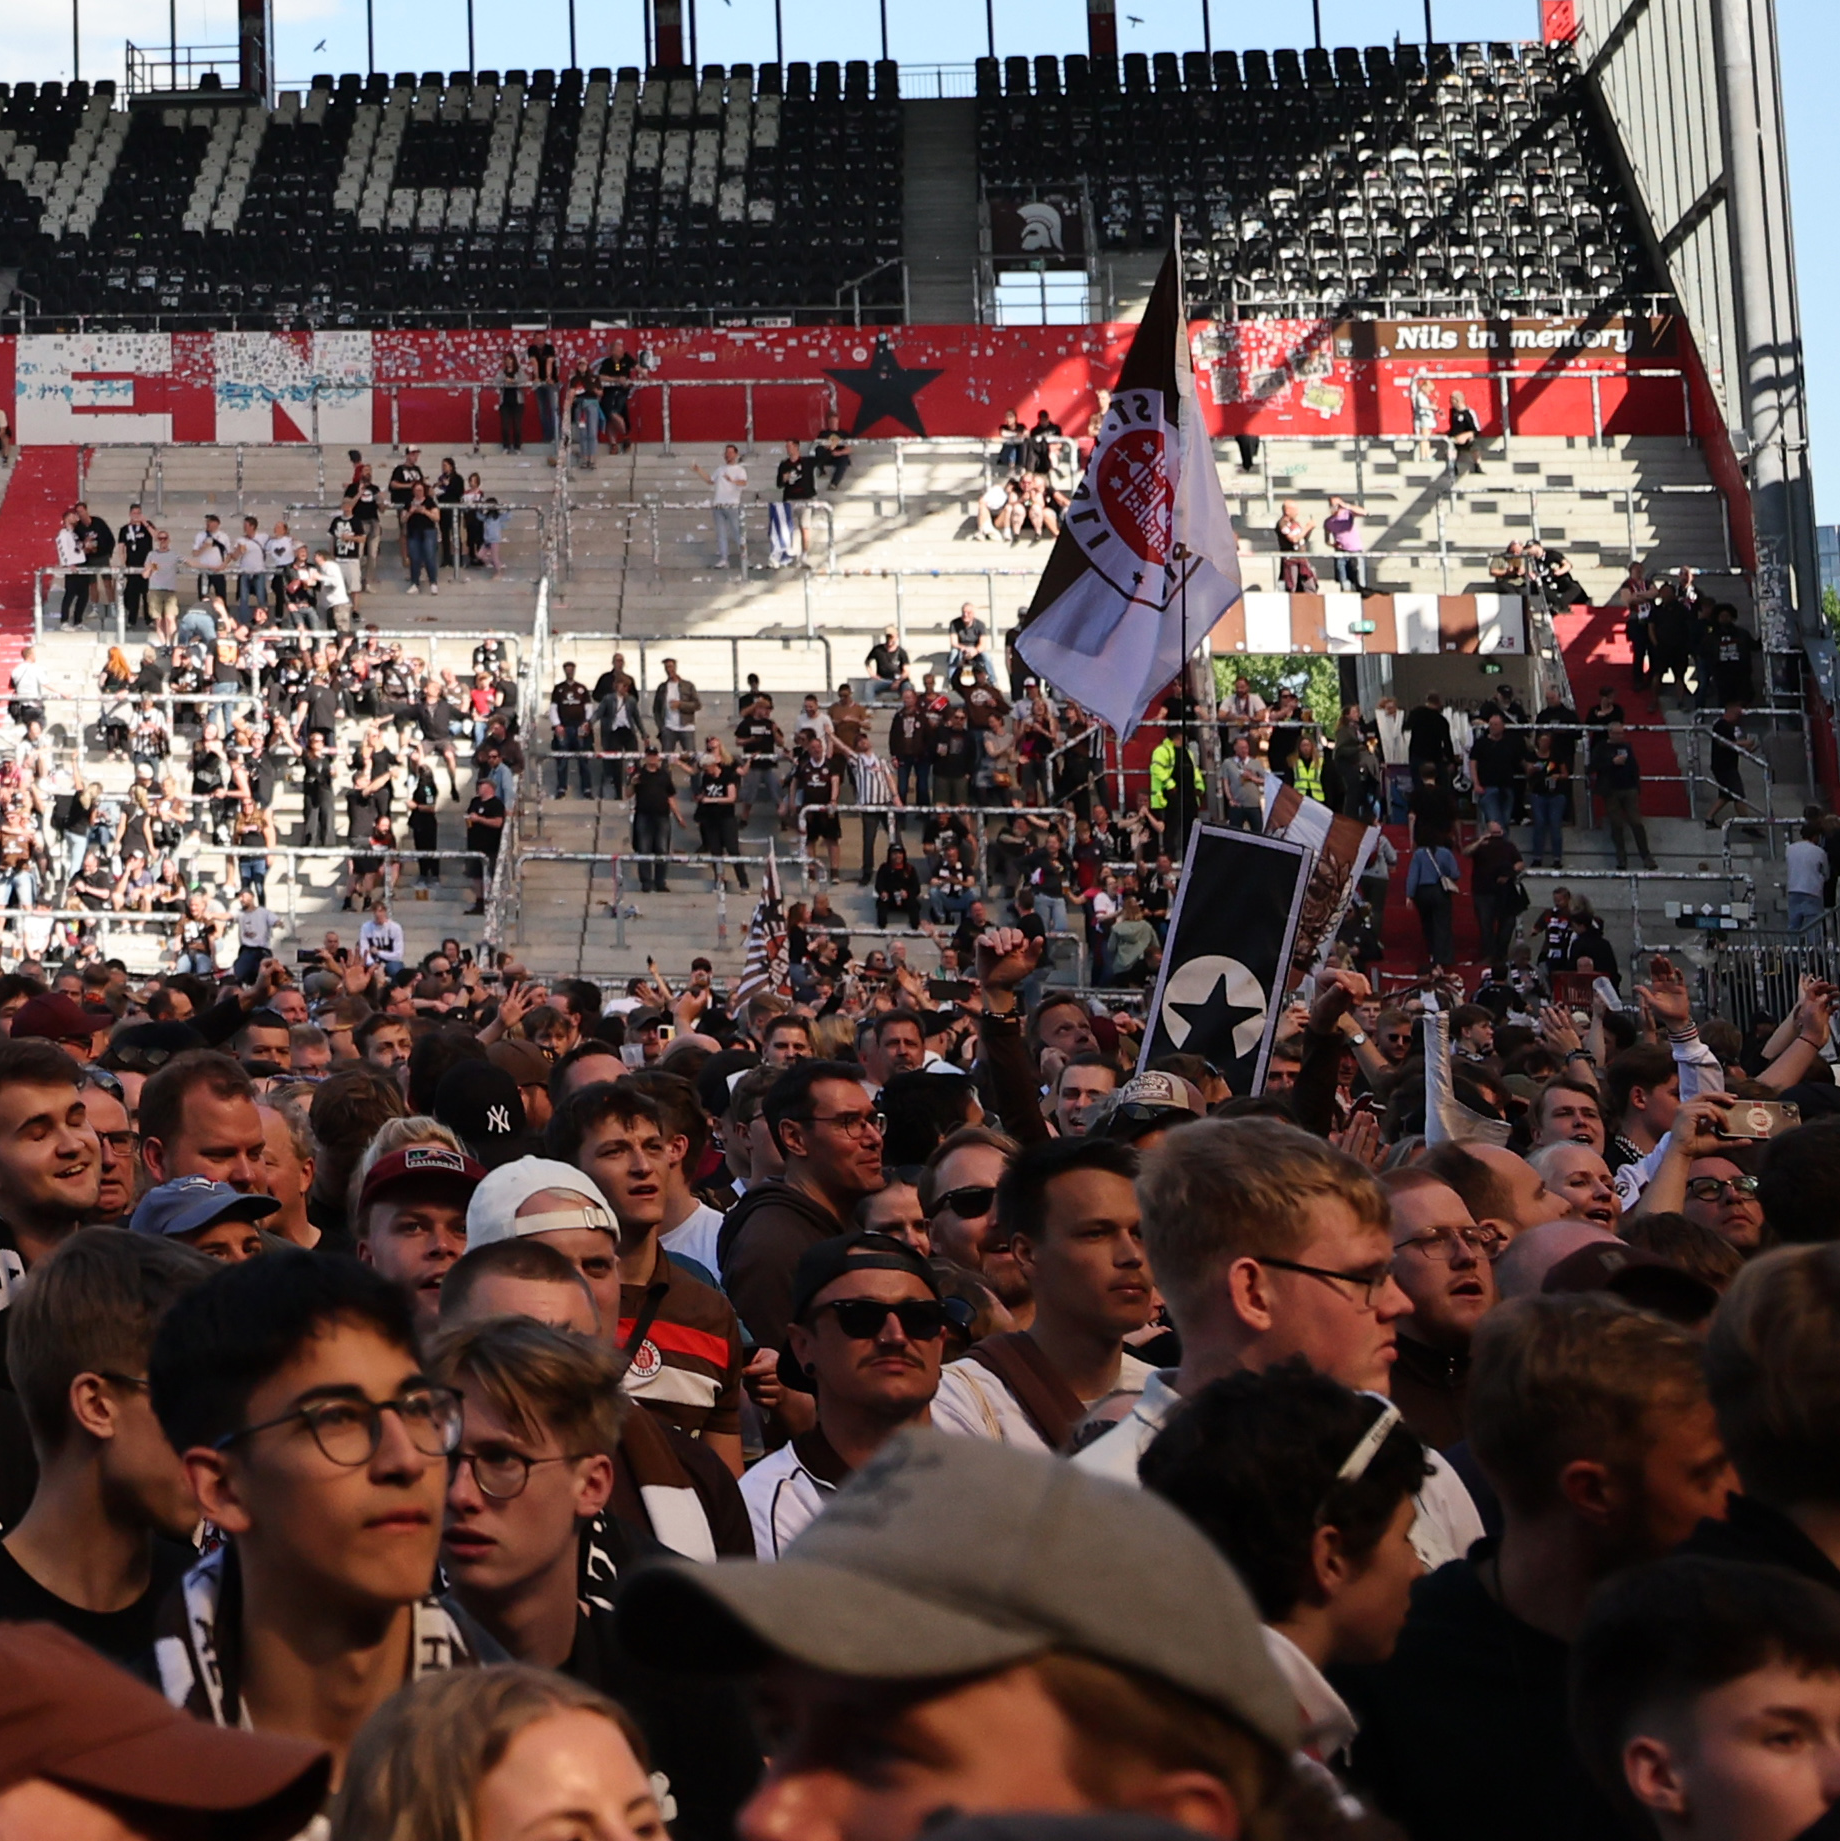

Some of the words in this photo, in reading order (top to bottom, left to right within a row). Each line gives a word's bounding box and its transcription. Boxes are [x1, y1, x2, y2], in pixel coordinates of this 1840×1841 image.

[1395, 325, 1458, 351] Nils
[1467, 323, 1499, 350] in
[1509, 323, 1635, 354] memory
[487, 1104, 512, 1133] NY
